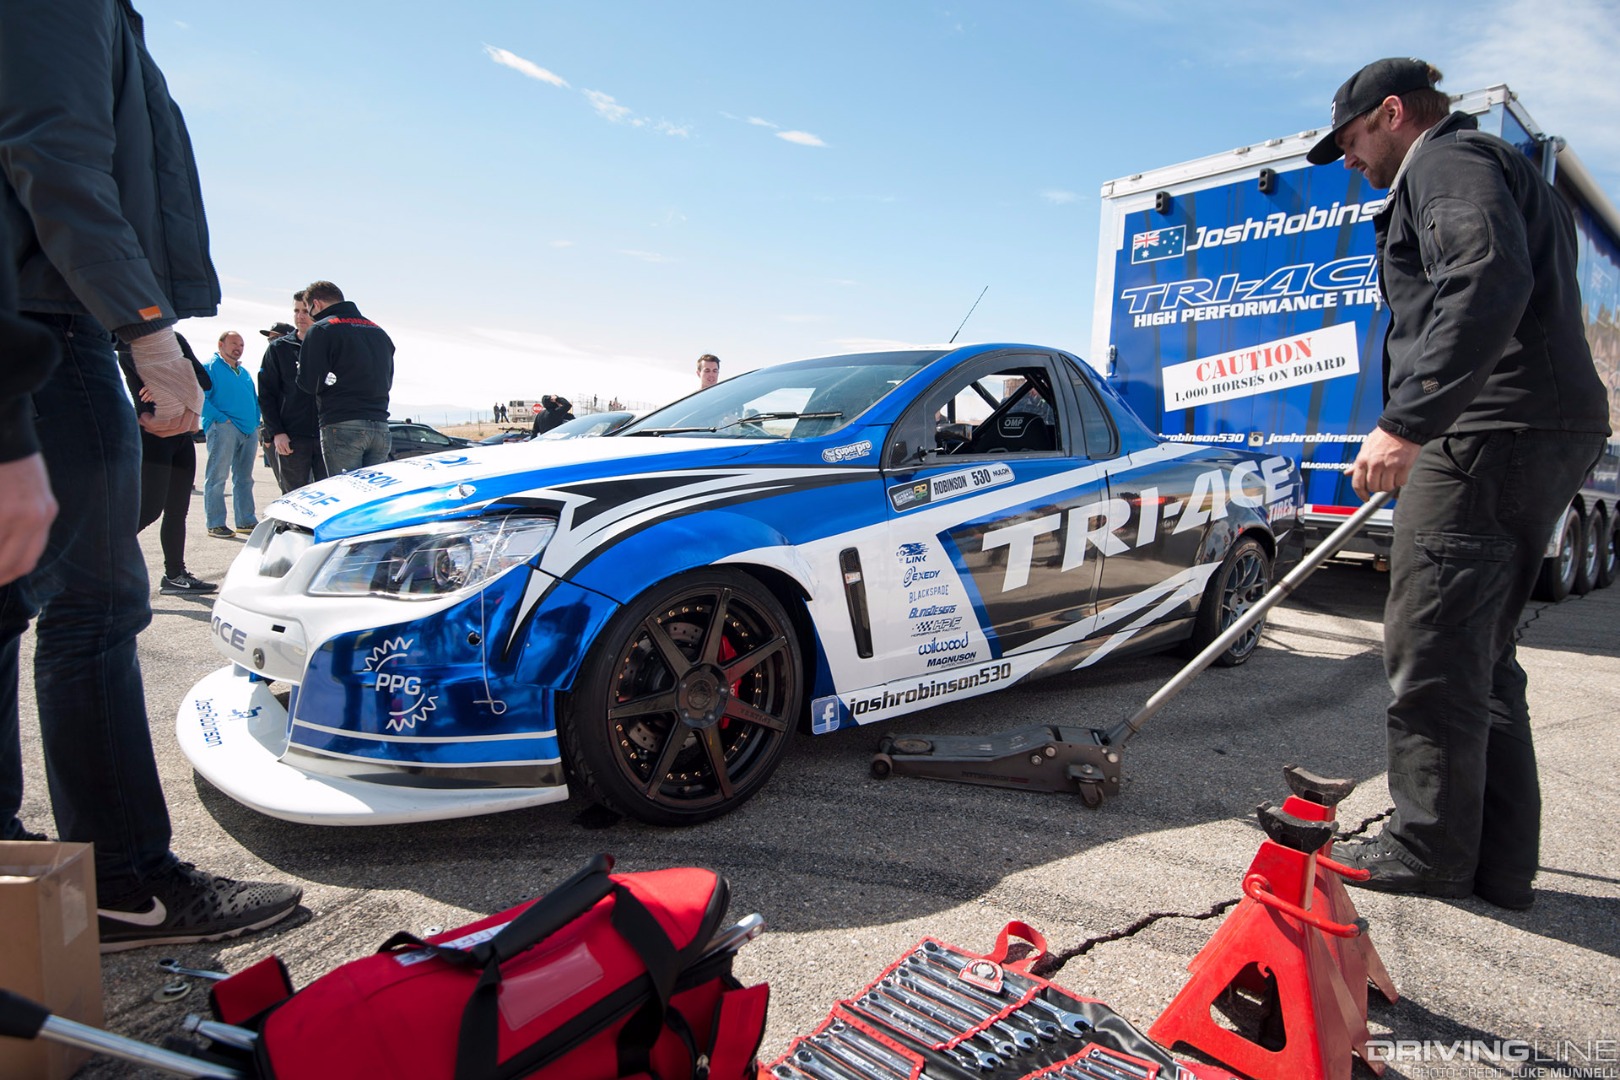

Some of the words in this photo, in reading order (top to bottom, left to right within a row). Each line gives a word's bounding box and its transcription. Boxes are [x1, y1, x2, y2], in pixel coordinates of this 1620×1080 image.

[1134, 306, 1176, 328] HIGH
[1181, 292, 1337, 323] PERFORMANCE
[1196, 337, 1313, 382] CAUTION
[1175, 386, 1208, 402] 1,000
[1212, 374, 1265, 394] HORSES
[1269, 370, 1288, 383] ON
[1294, 356, 1346, 377] BOARD
[1004, 418, 1024, 427] OMP
[1301, 462, 1352, 470] MAGNUSON
[933, 475, 968, 496] ROBINSON
[971, 468, 991, 487] 530
[993, 468, 1010, 477] NULON
[982, 456, 1293, 592] TRI-ACE
[1268, 497, 1294, 525] TIRES
[912, 570, 941, 581] EXEDY
[909, 585, 949, 603] BLACKSPADE
[918, 631, 969, 655] wilwood
[927, 651, 977, 667] MAGNUSON
[375, 673, 422, 695] PPG
[850, 662, 1011, 716] joshrobinson530
